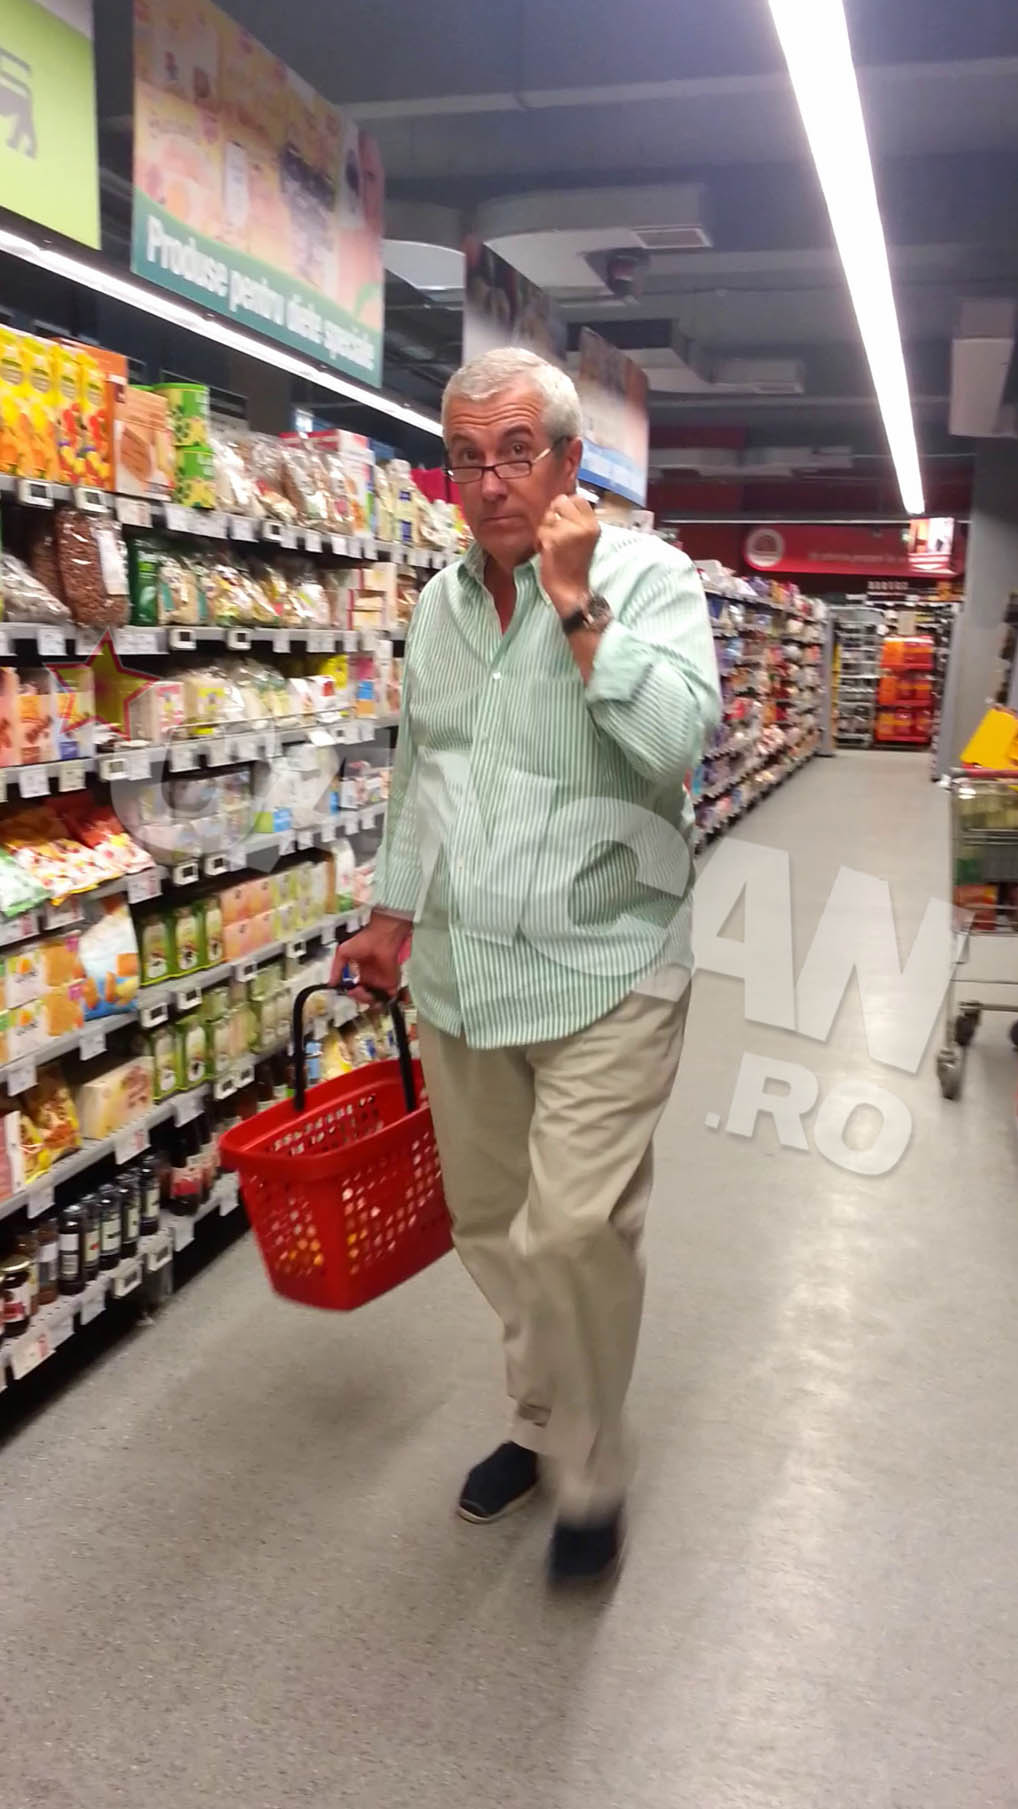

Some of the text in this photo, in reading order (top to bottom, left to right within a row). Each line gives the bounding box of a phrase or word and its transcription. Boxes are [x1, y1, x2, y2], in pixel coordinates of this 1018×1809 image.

[146, 215, 374, 371] Produse pentru diete speciale
